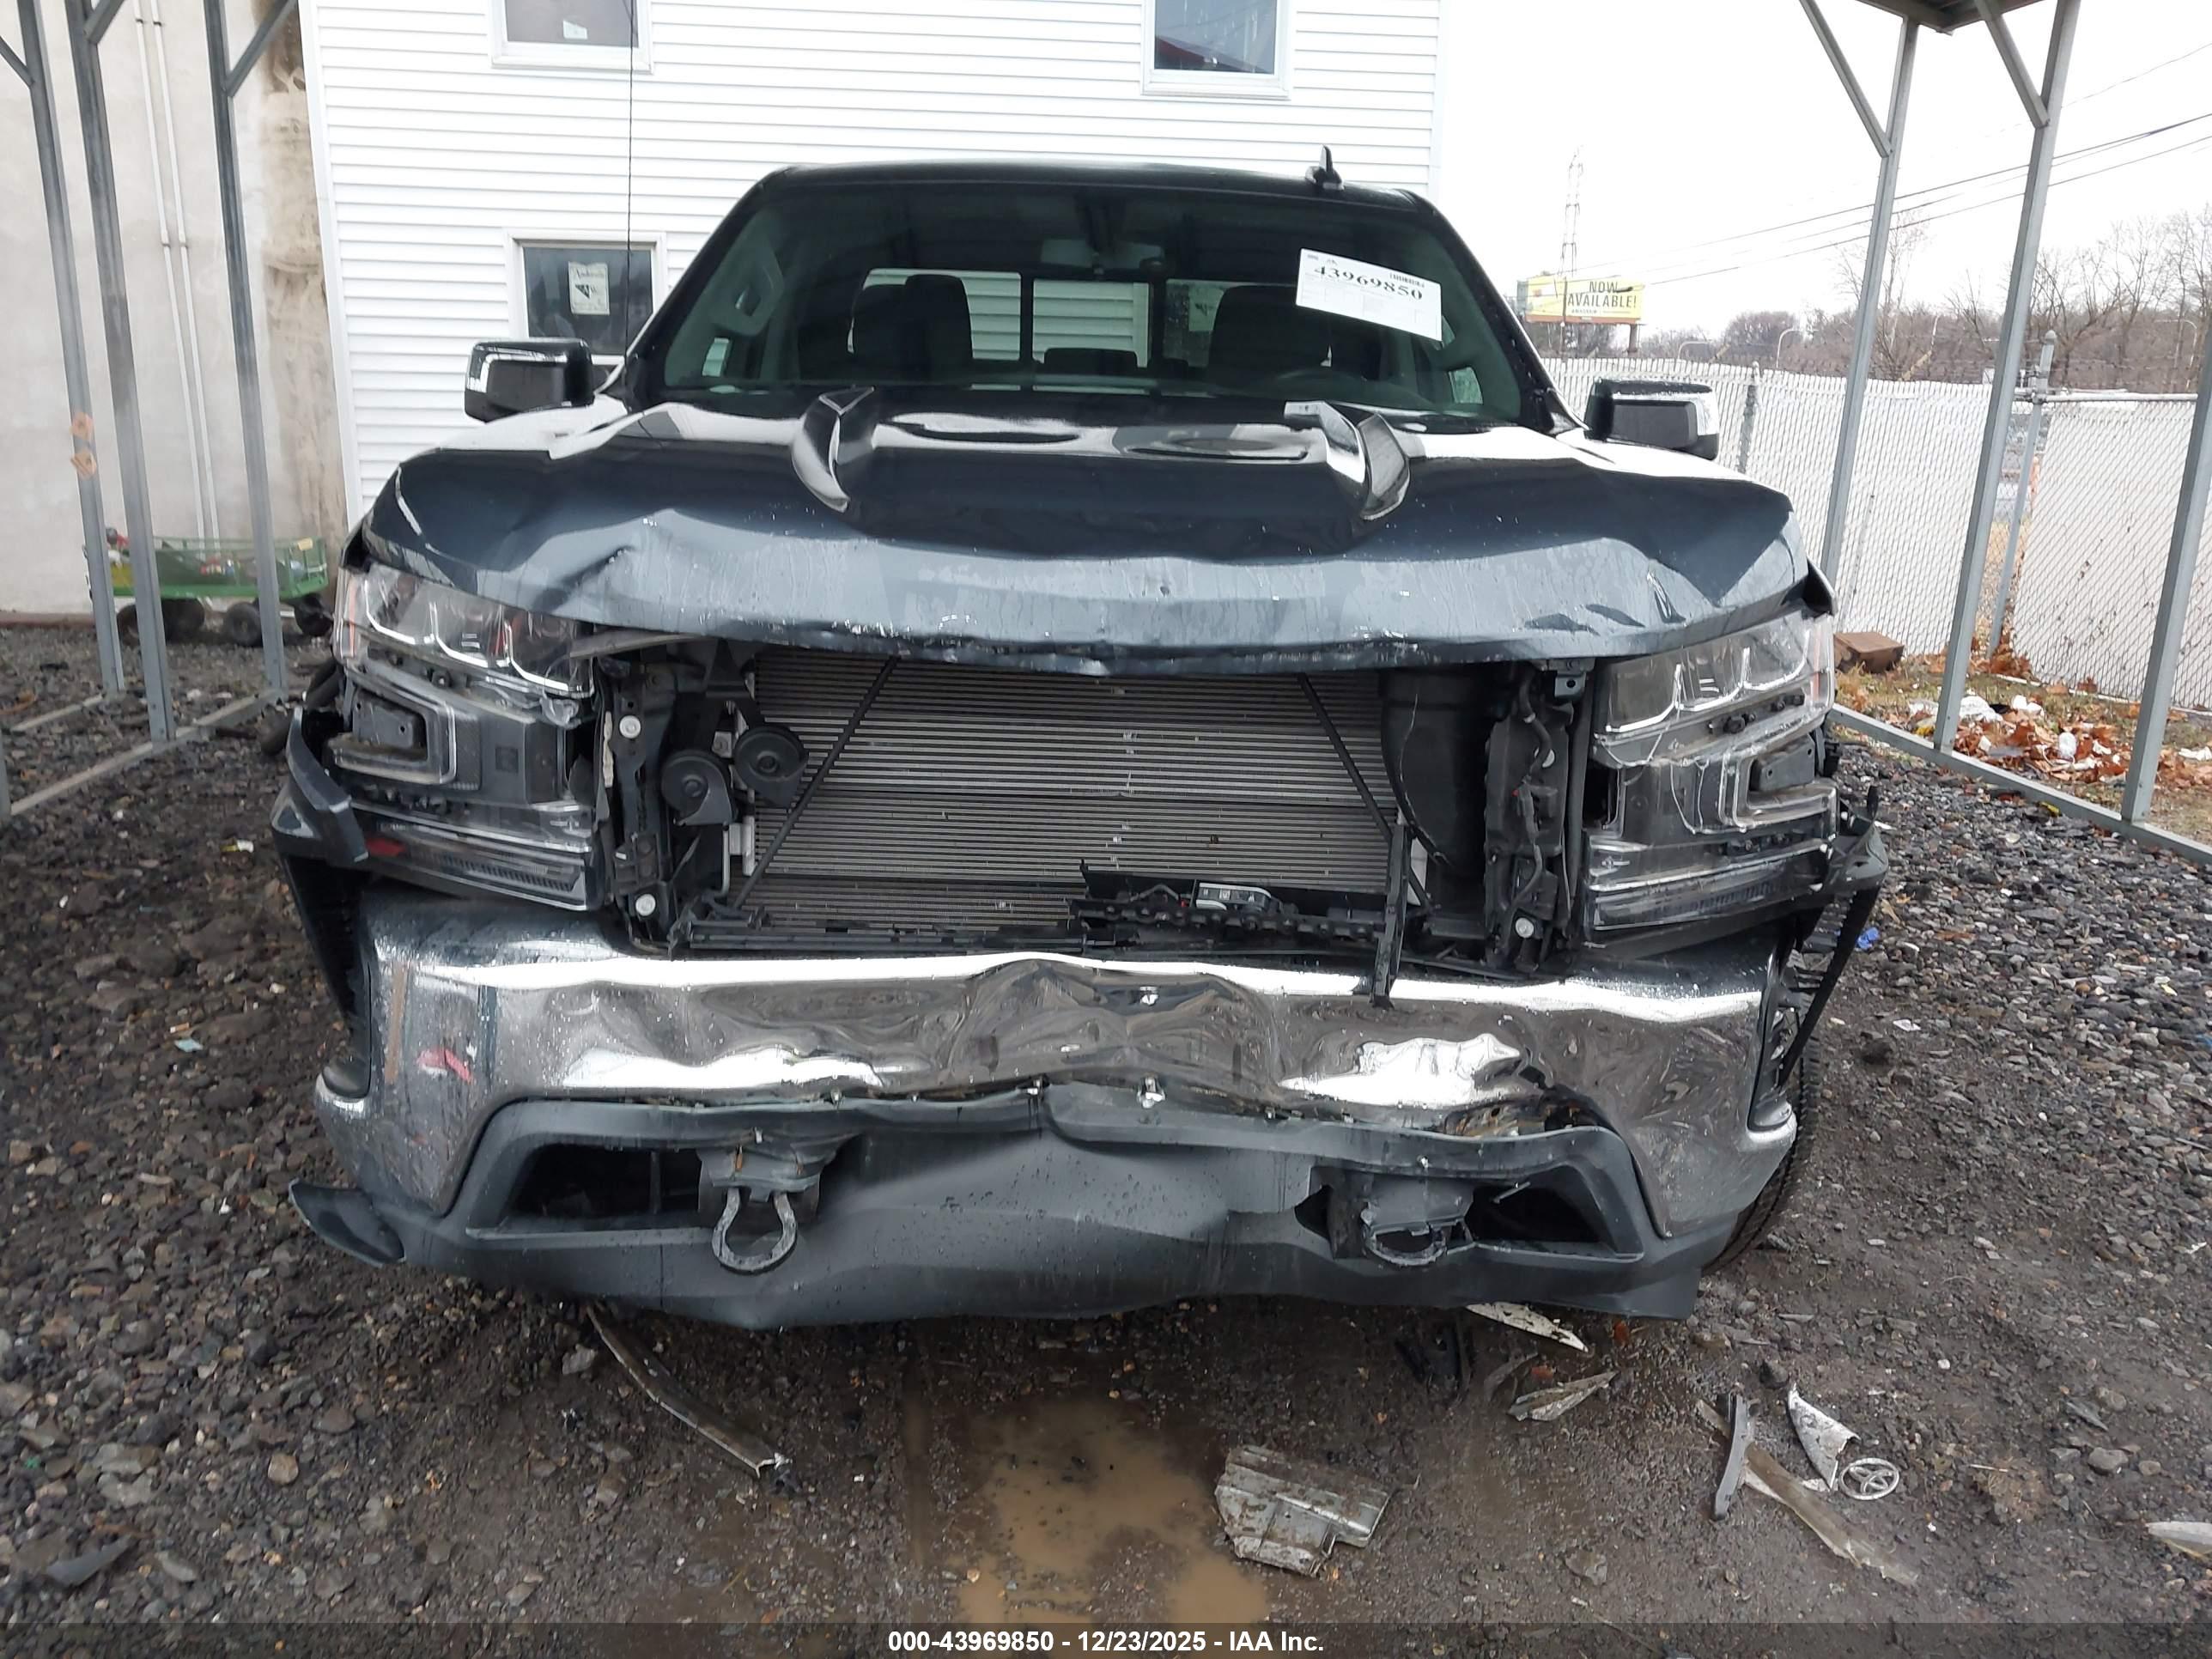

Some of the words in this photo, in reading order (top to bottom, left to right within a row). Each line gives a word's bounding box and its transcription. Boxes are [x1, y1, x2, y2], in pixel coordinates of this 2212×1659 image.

[1314, 265, 1423, 301] 43969850
[1589, 281, 1619, 294] NOW
[1567, 293, 1637, 308] AVAILABLE!
